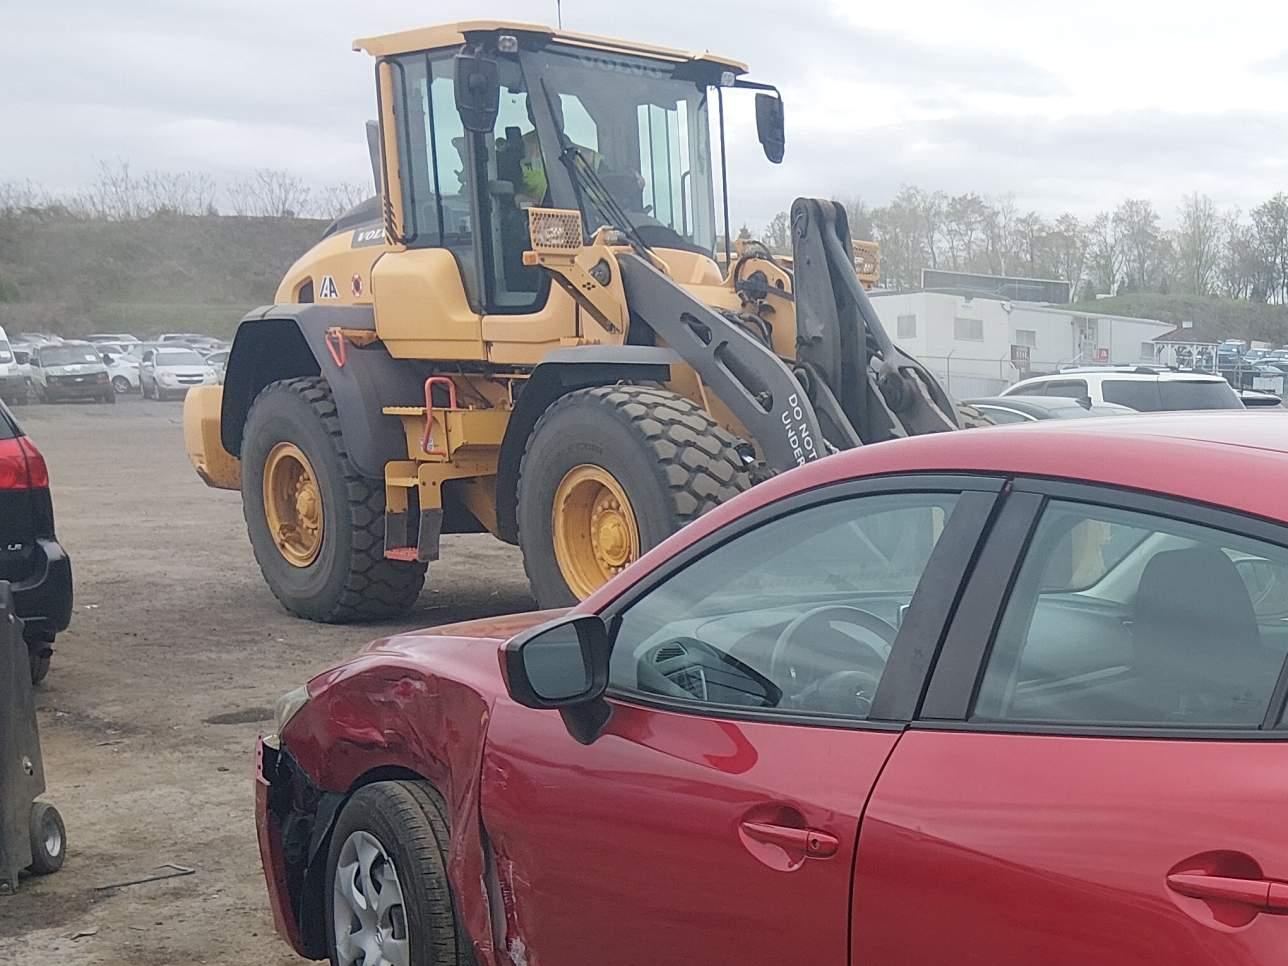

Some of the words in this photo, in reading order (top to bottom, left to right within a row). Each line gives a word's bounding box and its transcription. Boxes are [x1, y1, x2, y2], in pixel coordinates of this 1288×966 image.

[781, 411, 806, 465] UNDER
[788, 393, 802, 420] DO
[799, 423, 818, 459] NOT
